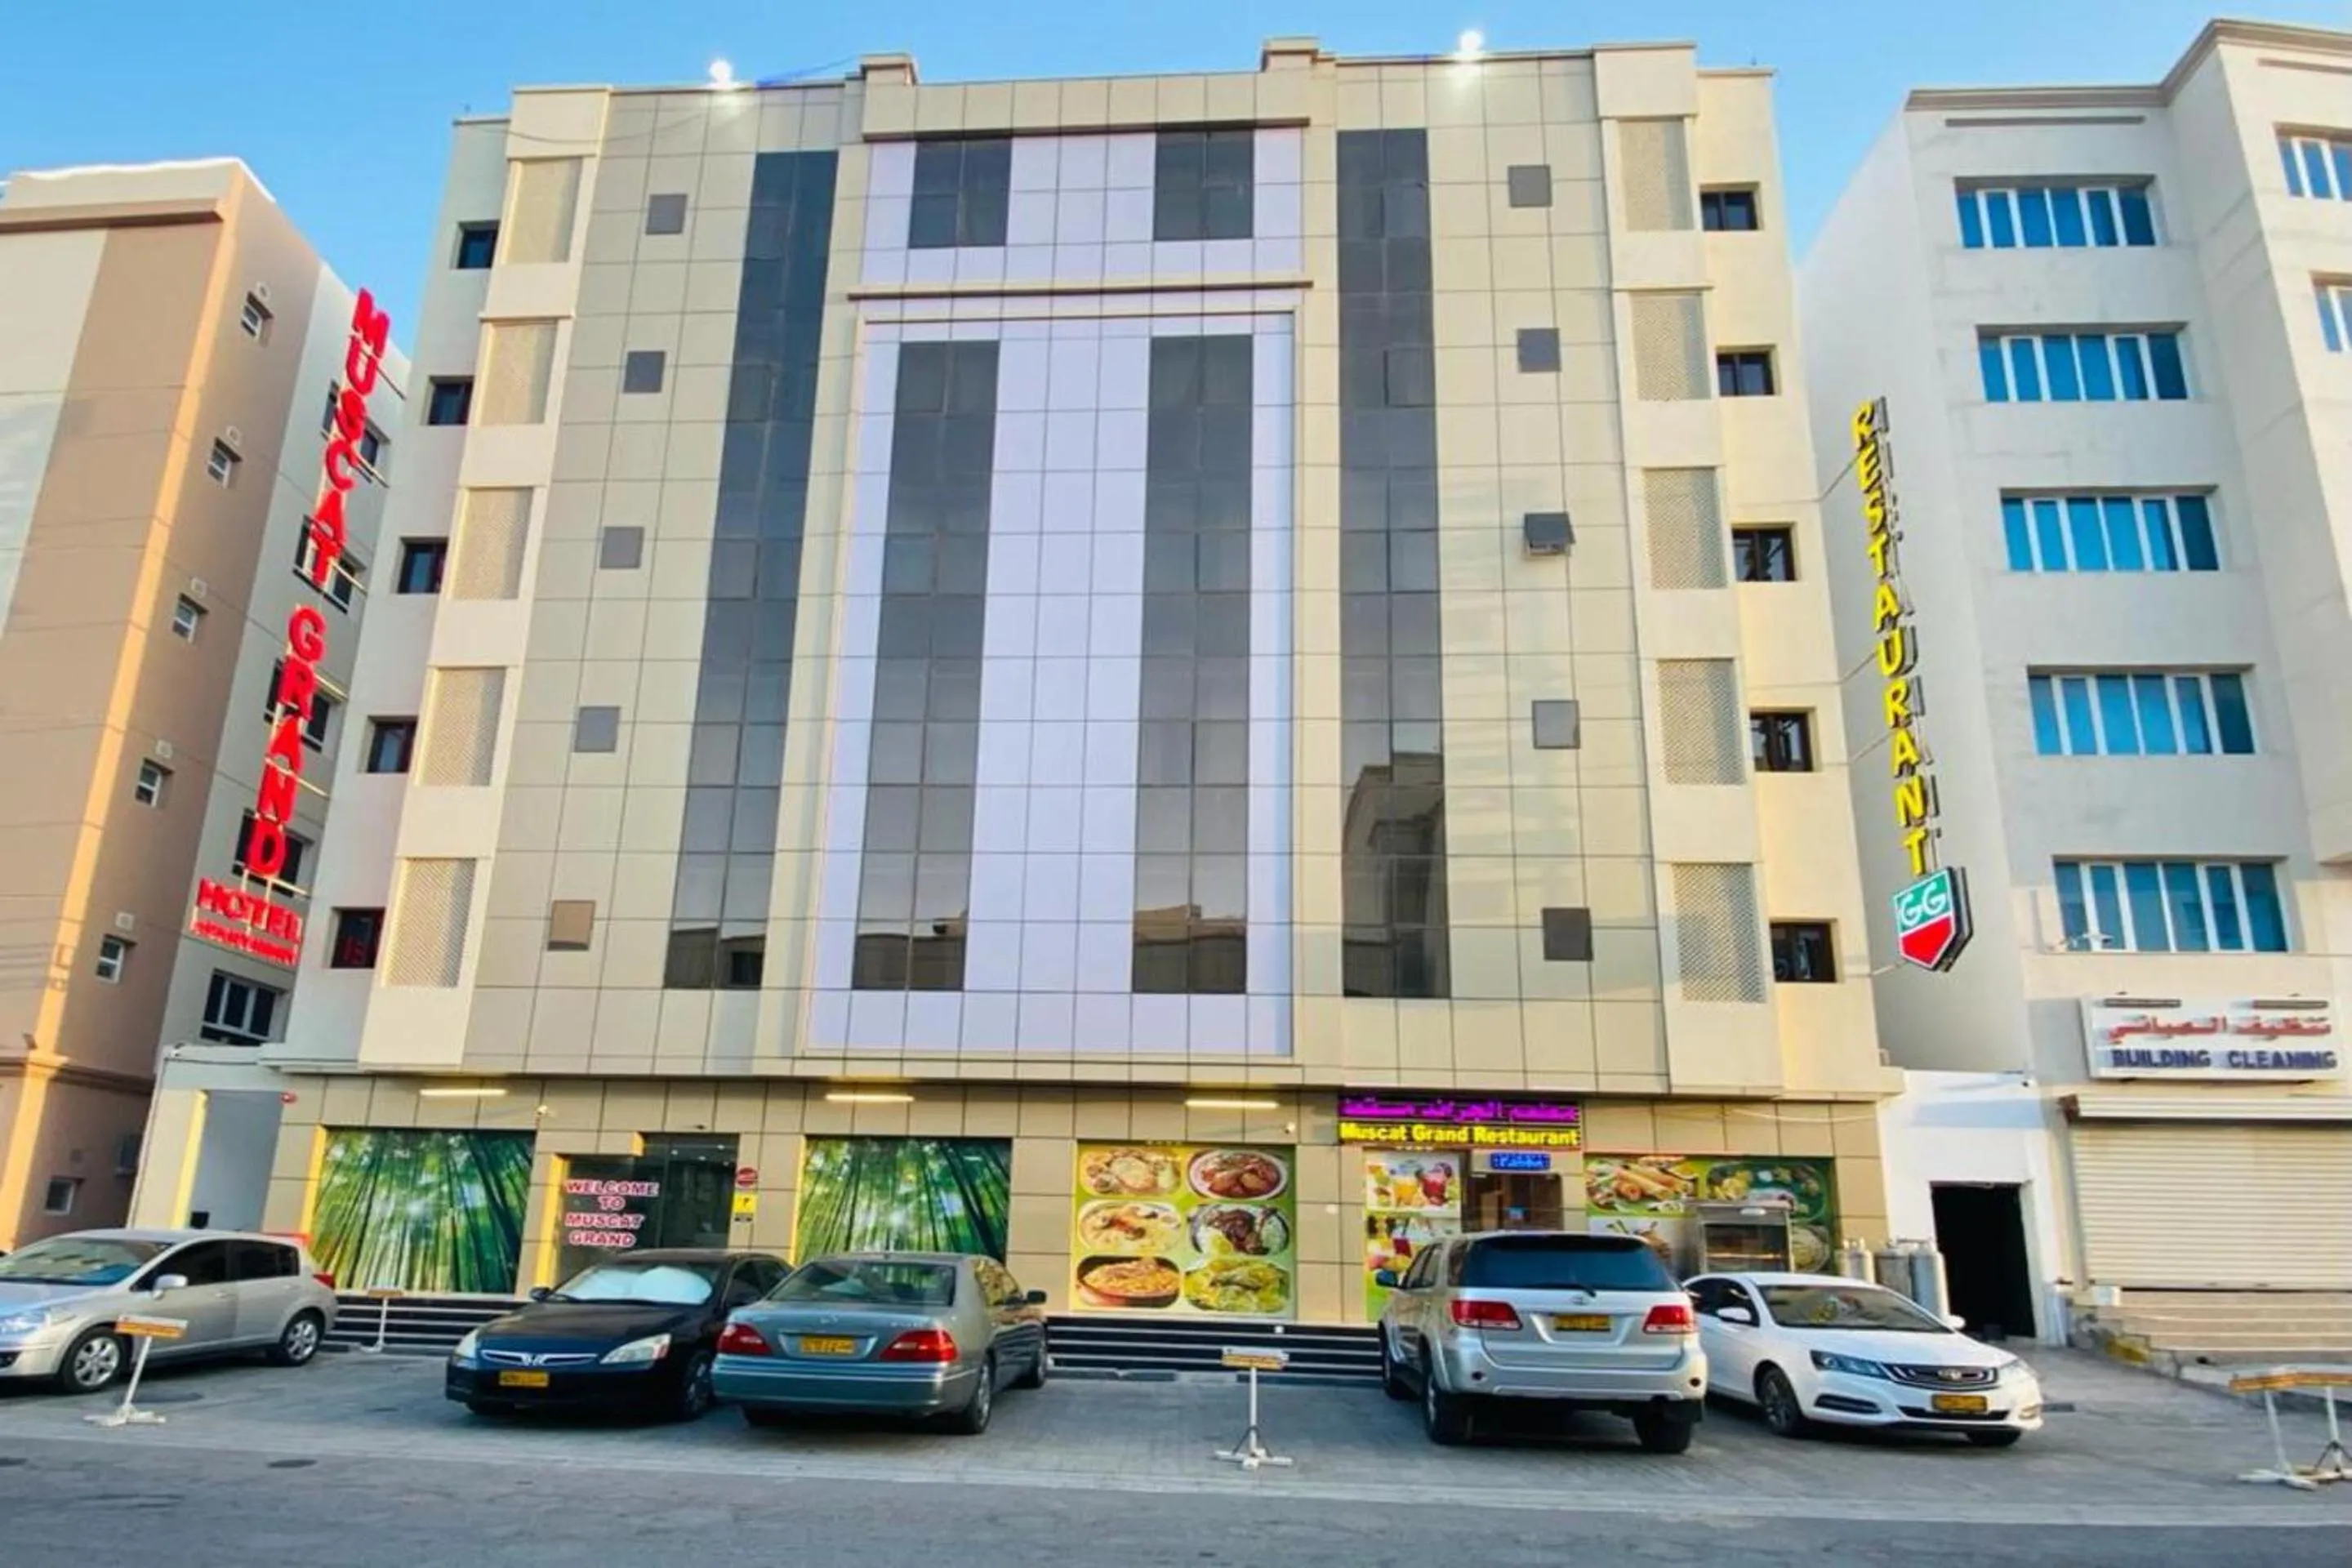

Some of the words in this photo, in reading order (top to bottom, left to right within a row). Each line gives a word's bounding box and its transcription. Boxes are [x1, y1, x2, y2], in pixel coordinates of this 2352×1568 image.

[306, 287, 390, 589] MUSCAT
[1851, 399, 1929, 877] RESTAURANT
[246, 605, 327, 876] GRAND
[197, 875, 304, 943] HOTEL
[2110, 1049, 2212, 1069] BUILDING
[2227, 1050, 2338, 1070] CLEANING
[1339, 1121, 1407, 1142] Muscat
[1411, 1124, 1469, 1143] Grand
[1473, 1125, 1581, 1146] Restaurant
[564, 1178, 660, 1196] WELCOME
[597, 1196, 626, 1210] TO
[564, 1213, 645, 1229] MUSCAT
[569, 1231, 637, 1248] GRAND
